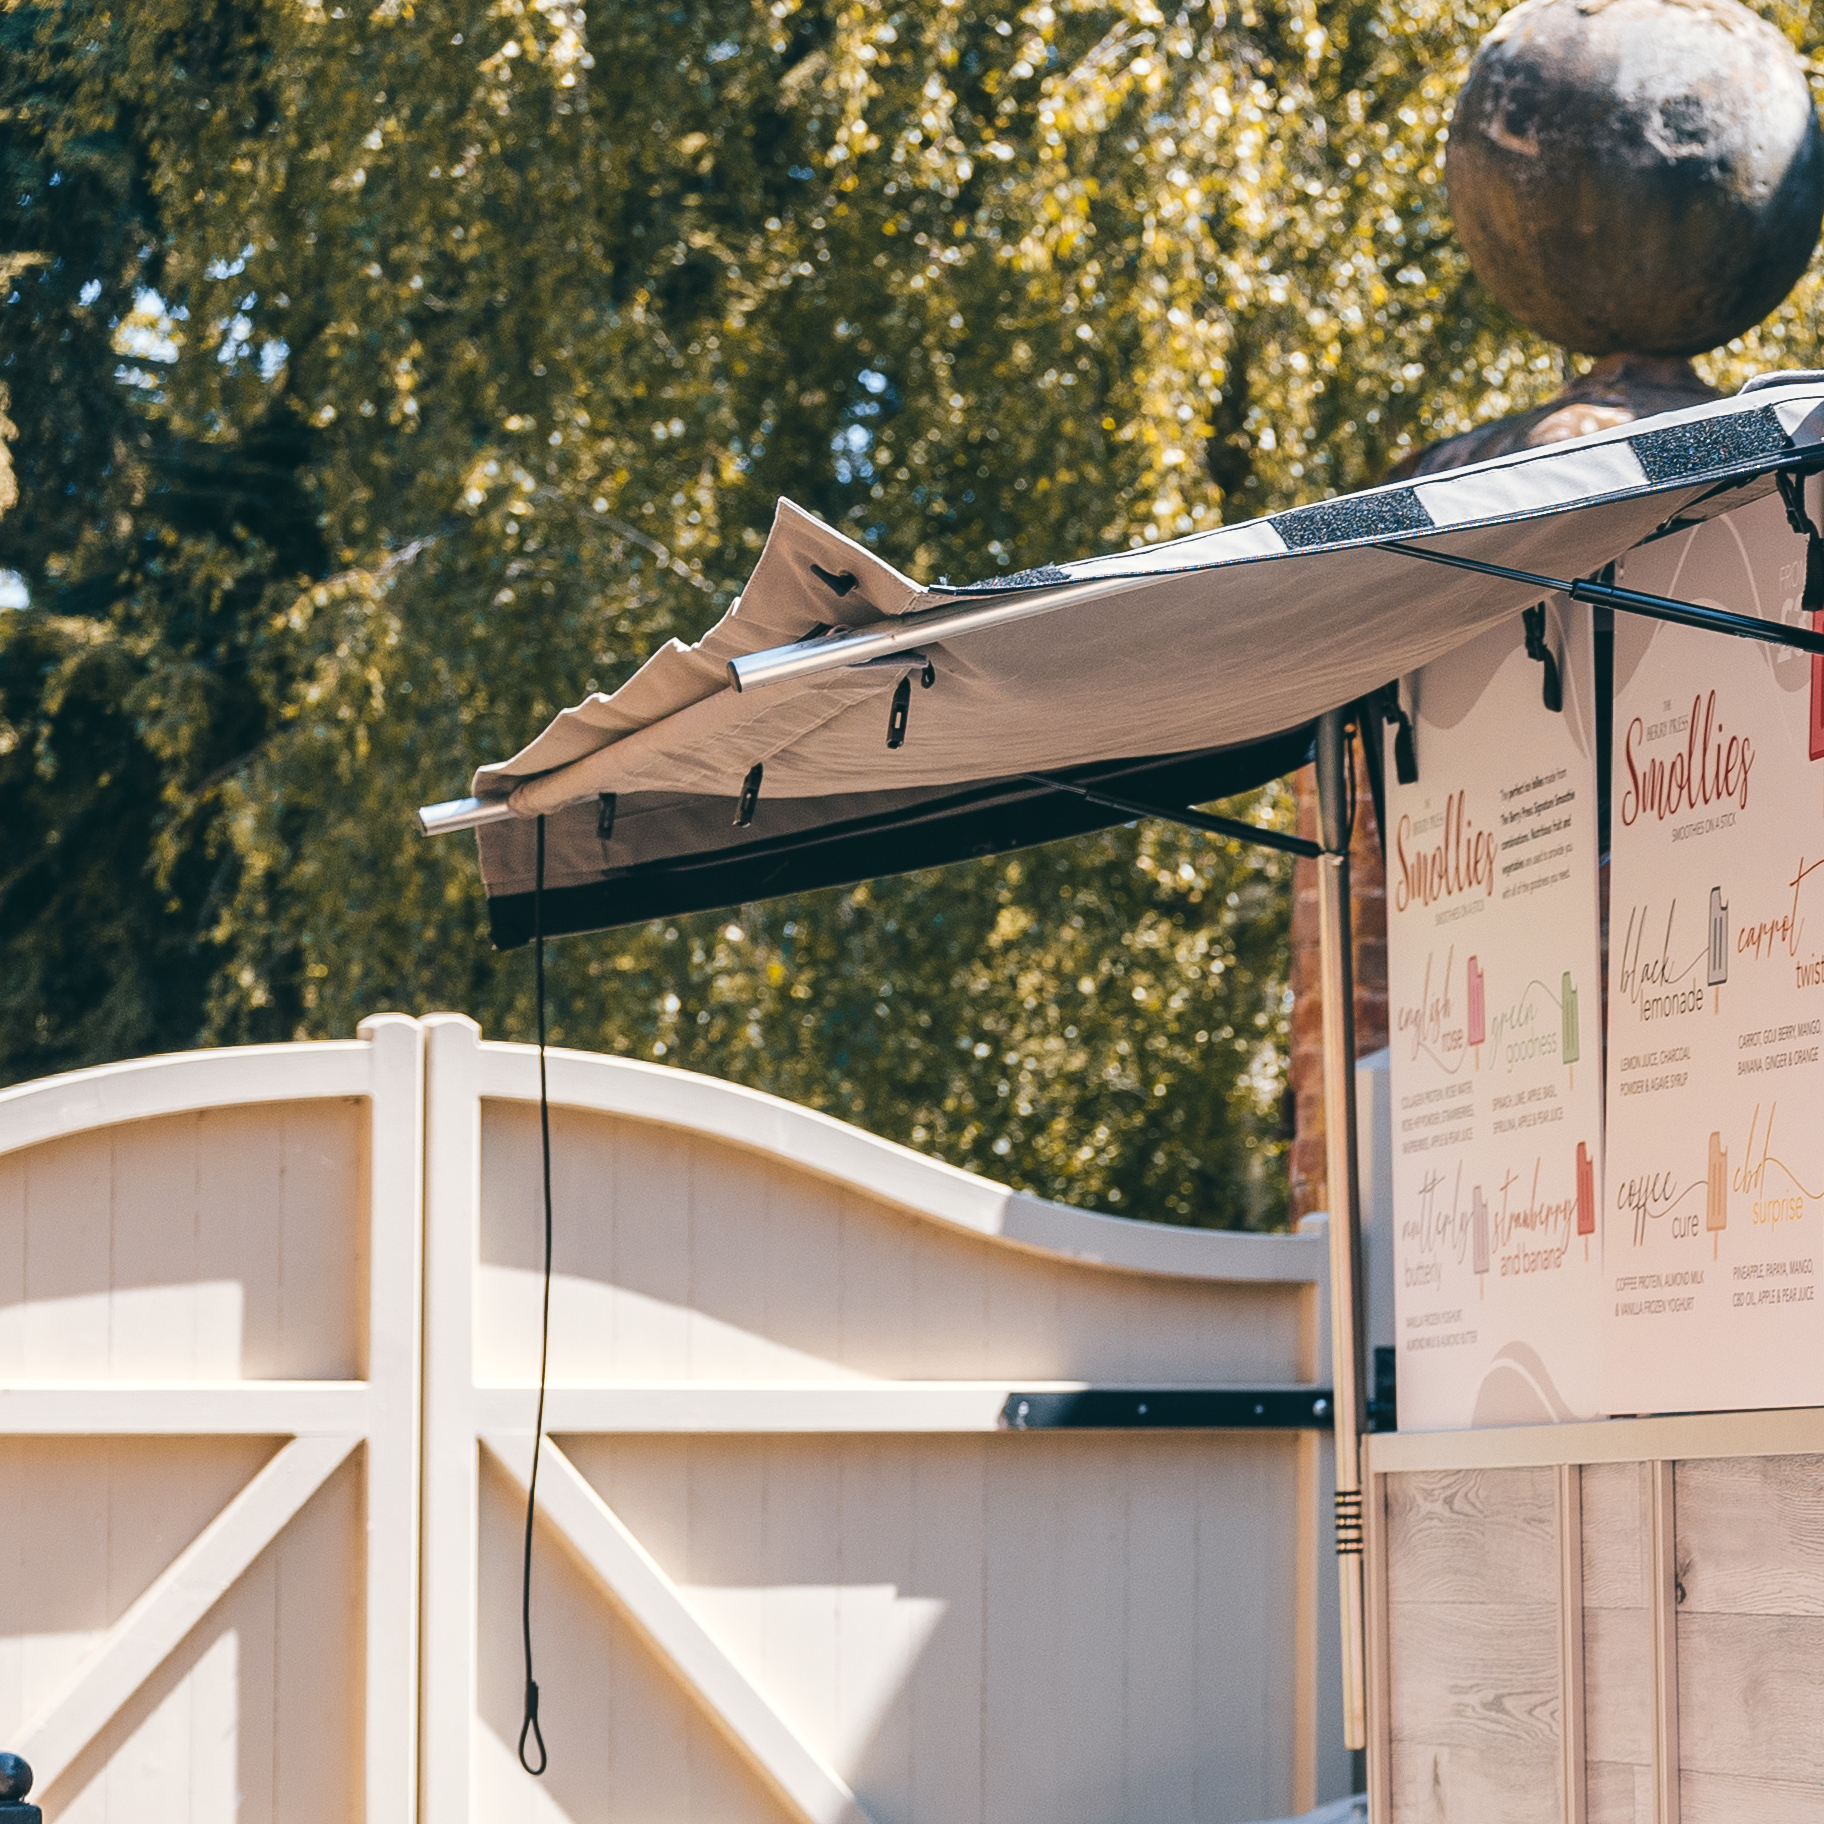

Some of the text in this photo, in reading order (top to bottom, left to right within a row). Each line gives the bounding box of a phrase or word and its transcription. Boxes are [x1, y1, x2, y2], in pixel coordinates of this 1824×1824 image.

[1622, 689, 1756, 827] Smollies
[1396, 789, 1498, 913] Smollies
[1620, 898, 1677, 1004] black
[1640, 977, 1704, 1022] lemonade
[1441, 1028, 1464, 1052] rose
[1505, 1025, 1558, 1074] goodness
[1738, 1031, 1763, 1050] CARROT,
[1796, 1019, 1822, 1038] MANGO,
[1620, 1055, 1642, 1072] LEMON
[1659, 1046, 1691, 1066] CHARCOAL
[1764, 1053, 1788, 1071] GINGER
[1793, 1046, 1819, 1066] ORANGE
[1619, 1080, 1644, 1097] POWDER
[1649, 1074, 1670, 1092] AGAVE
[1669, 1072, 1688, 1089] SYRUP
[1733, 1100, 1778, 1200] cbd
[1491, 1156, 1577, 1255] strawberry
[1617, 1170, 1677, 1247] coffee
[1752, 1188, 1804, 1233] surprise
[1671, 1213, 1699, 1240] cure
[1500, 1241, 1562, 1277] and banana
[1733, 1258, 1815, 1281] PINEAPPLE, PAPAYA, MANGO,
[1615, 1276, 1637, 1292] COFFEE
[1664, 1271, 1690, 1287] ALMOND
[1690, 1269, 1705, 1285] MILK
[1732, 1292, 1745, 1307] CBD
[1758, 1289, 1776, 1305] APPLE
[1776, 1288, 1782, 1303] &
[1782, 1286, 1797, 1303] PEAR
[1797, 1285, 1815, 1301] JUICE
[1621, 1300, 1643, 1316] VANILLA
[1643, 1298, 1667, 1314] FROZEN
[1667, 1296, 1695, 1313] YOGHURT
